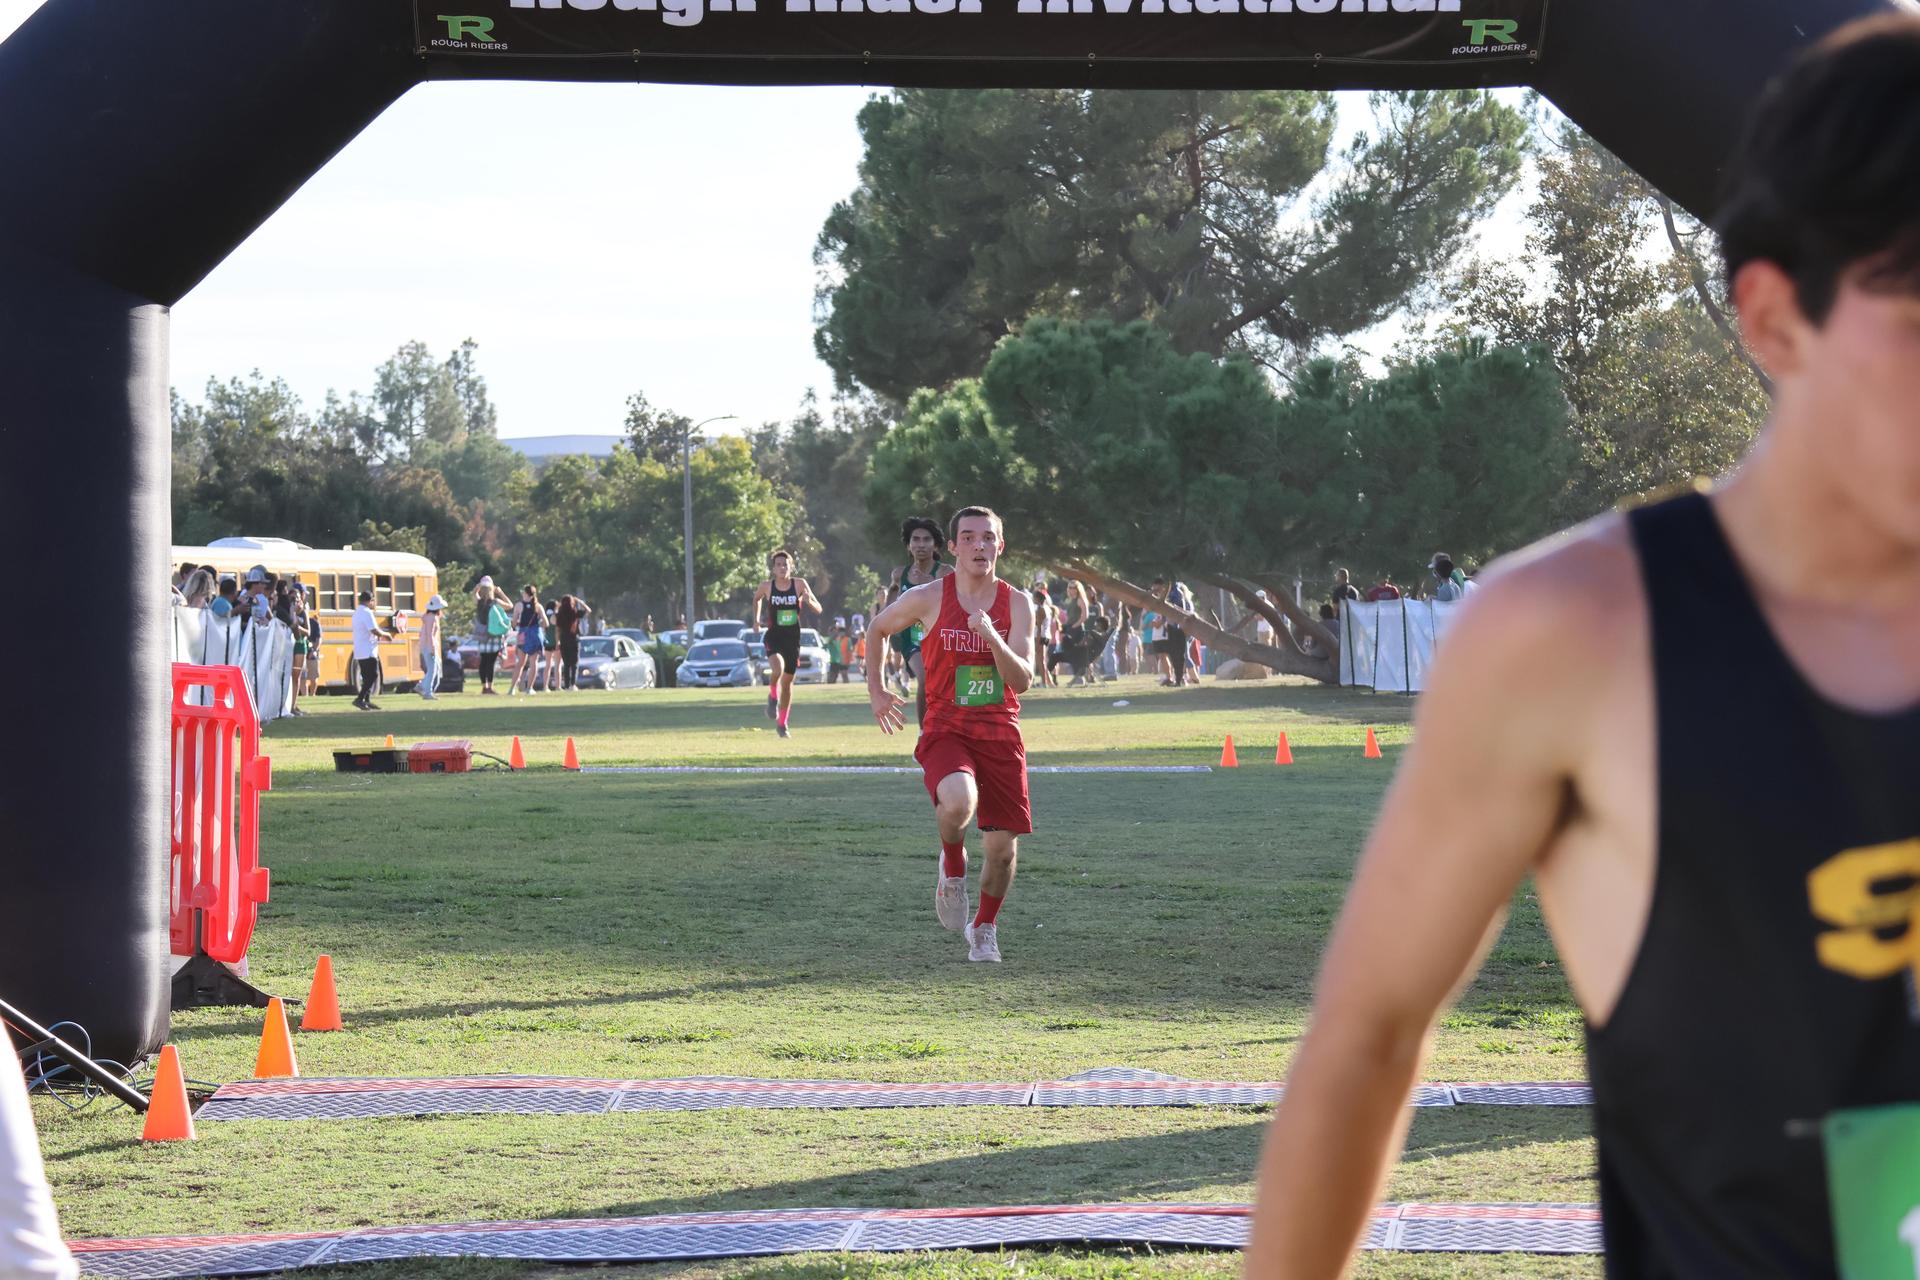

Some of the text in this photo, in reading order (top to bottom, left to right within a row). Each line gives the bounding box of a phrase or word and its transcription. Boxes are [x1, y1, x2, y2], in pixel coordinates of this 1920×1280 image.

[431, 39, 508, 50] ROUGH RIDERS
[1451, 43, 1528, 55] ROUGH RIDERS
[771, 595, 797, 605] FOWLER
[967, 679, 994, 695] 279
